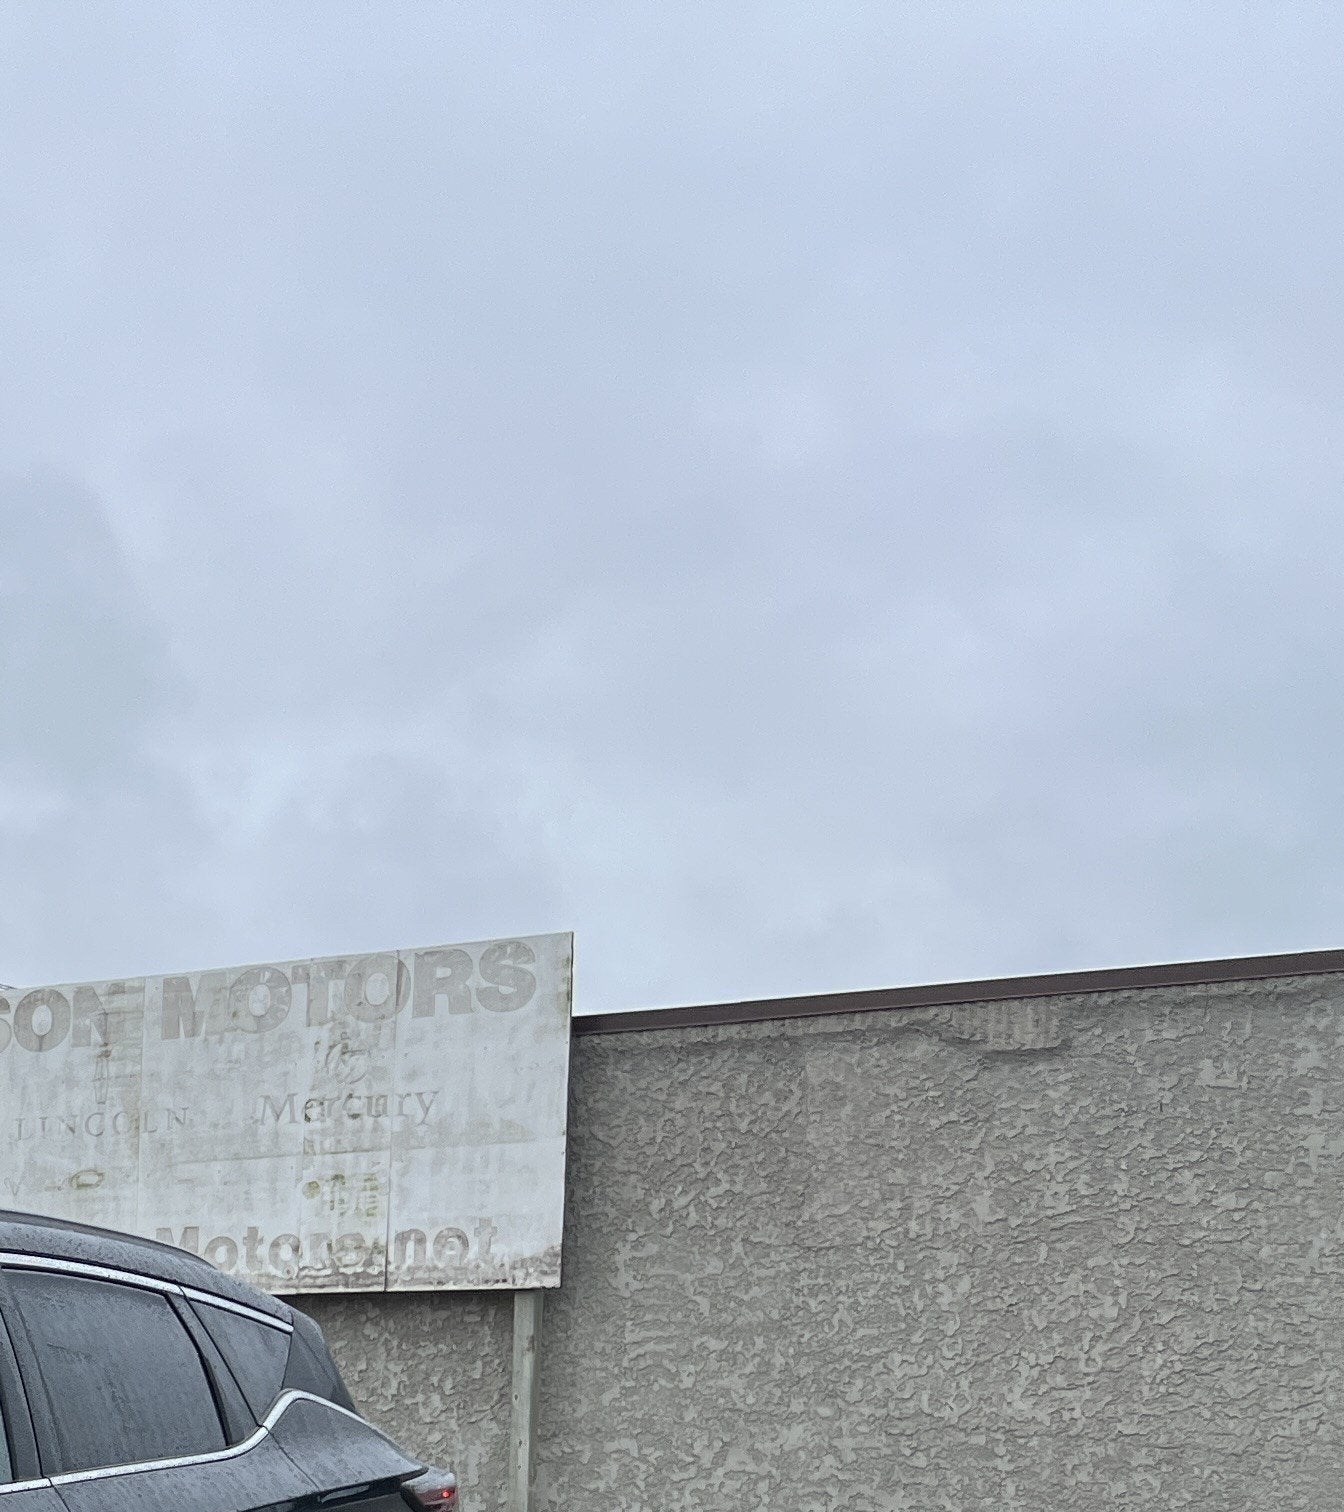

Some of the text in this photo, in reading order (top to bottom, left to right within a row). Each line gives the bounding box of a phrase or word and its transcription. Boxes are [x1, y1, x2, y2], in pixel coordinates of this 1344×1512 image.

[162, 940, 537, 1041] MOTORS
[14, 1107, 190, 1142] LINCOLN
[260, 1089, 440, 1128] Mercury
